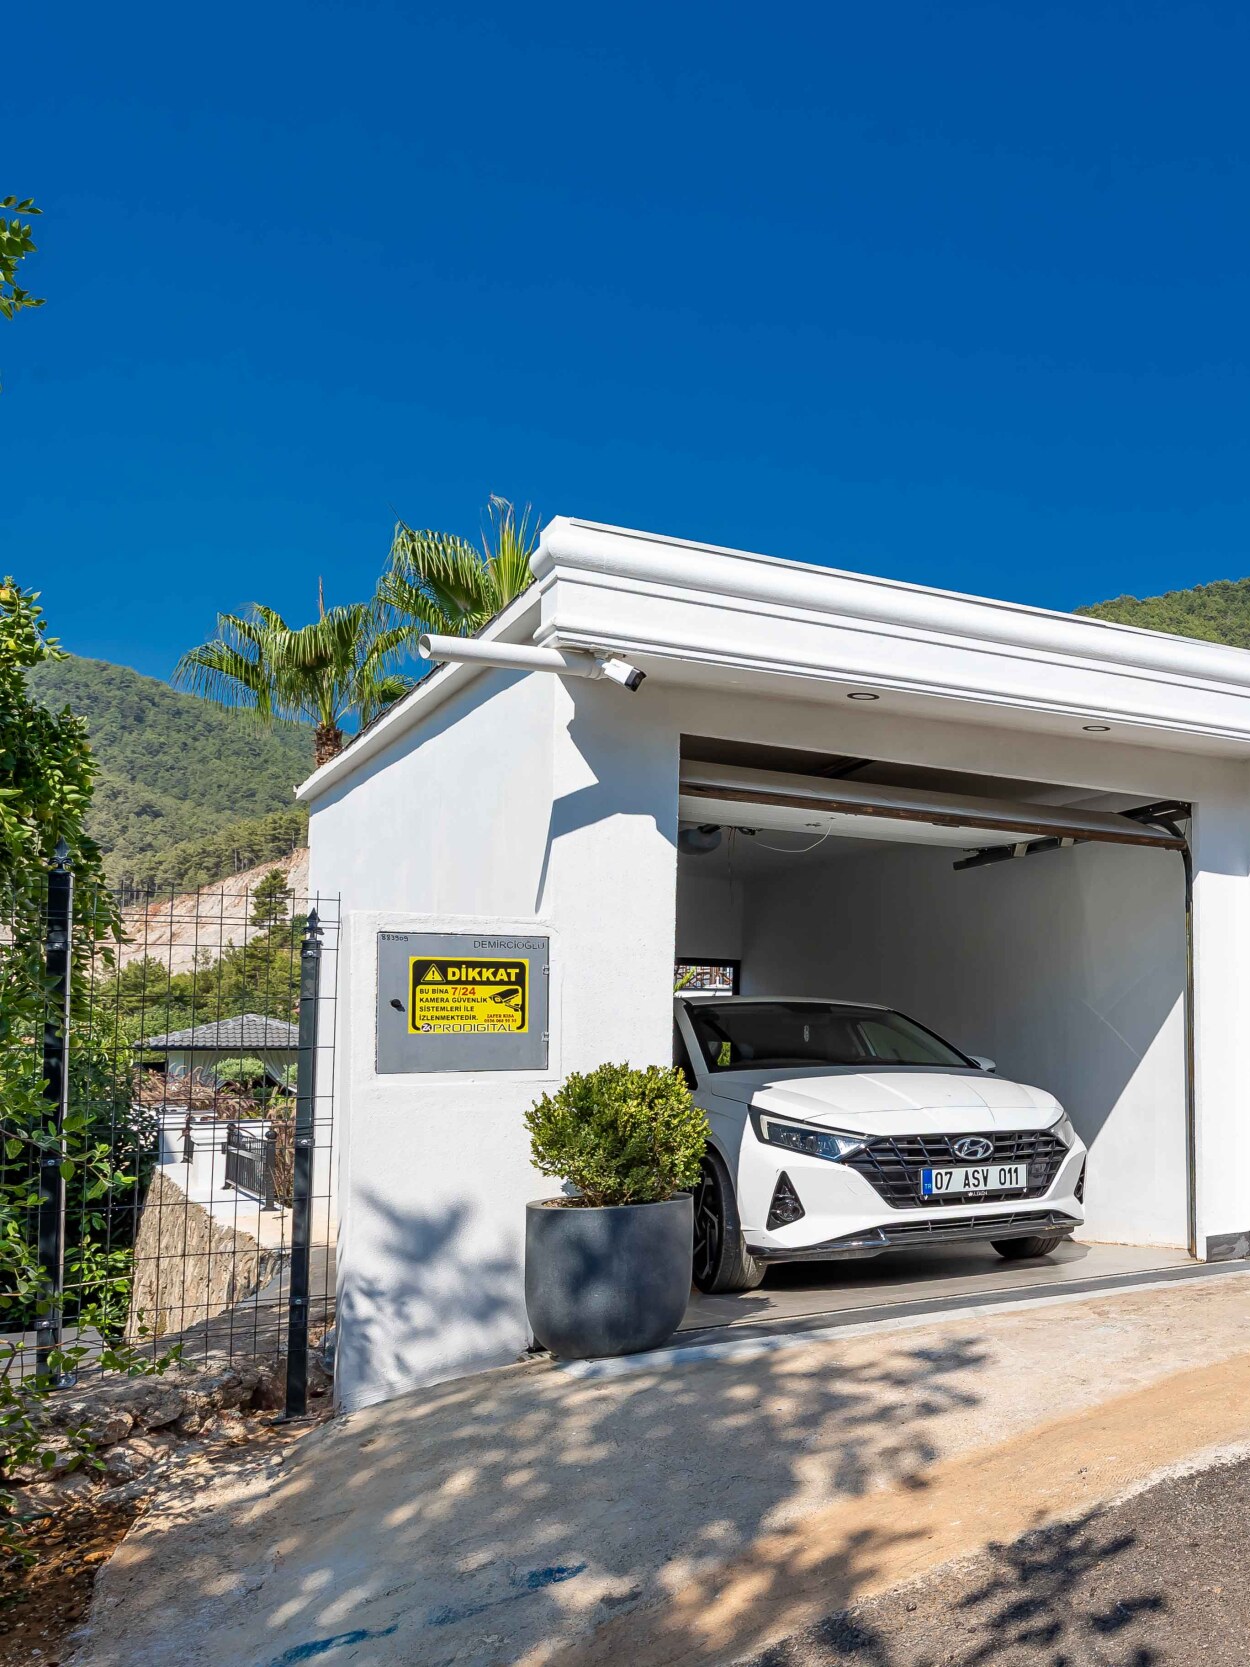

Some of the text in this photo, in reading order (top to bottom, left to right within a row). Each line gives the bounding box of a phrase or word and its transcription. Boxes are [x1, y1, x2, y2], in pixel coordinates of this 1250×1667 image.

[473, 940, 545, 950] DEMİRCİOĞLU
[447, 964, 520, 982] DİKKAT
[431, 987, 449, 995] BİNA
[451, 986, 476, 996] 7/24
[451, 996, 488, 1004] GÜVENLİK
[418, 1013, 479, 1021] İZLENMEKTEDİR.
[433, 1023, 516, 1032] PRODIGITAL
[935, 1171, 953, 1190] 07
[963, 1168, 989, 1188] ASV
[998, 1166, 1019, 1186] 011
